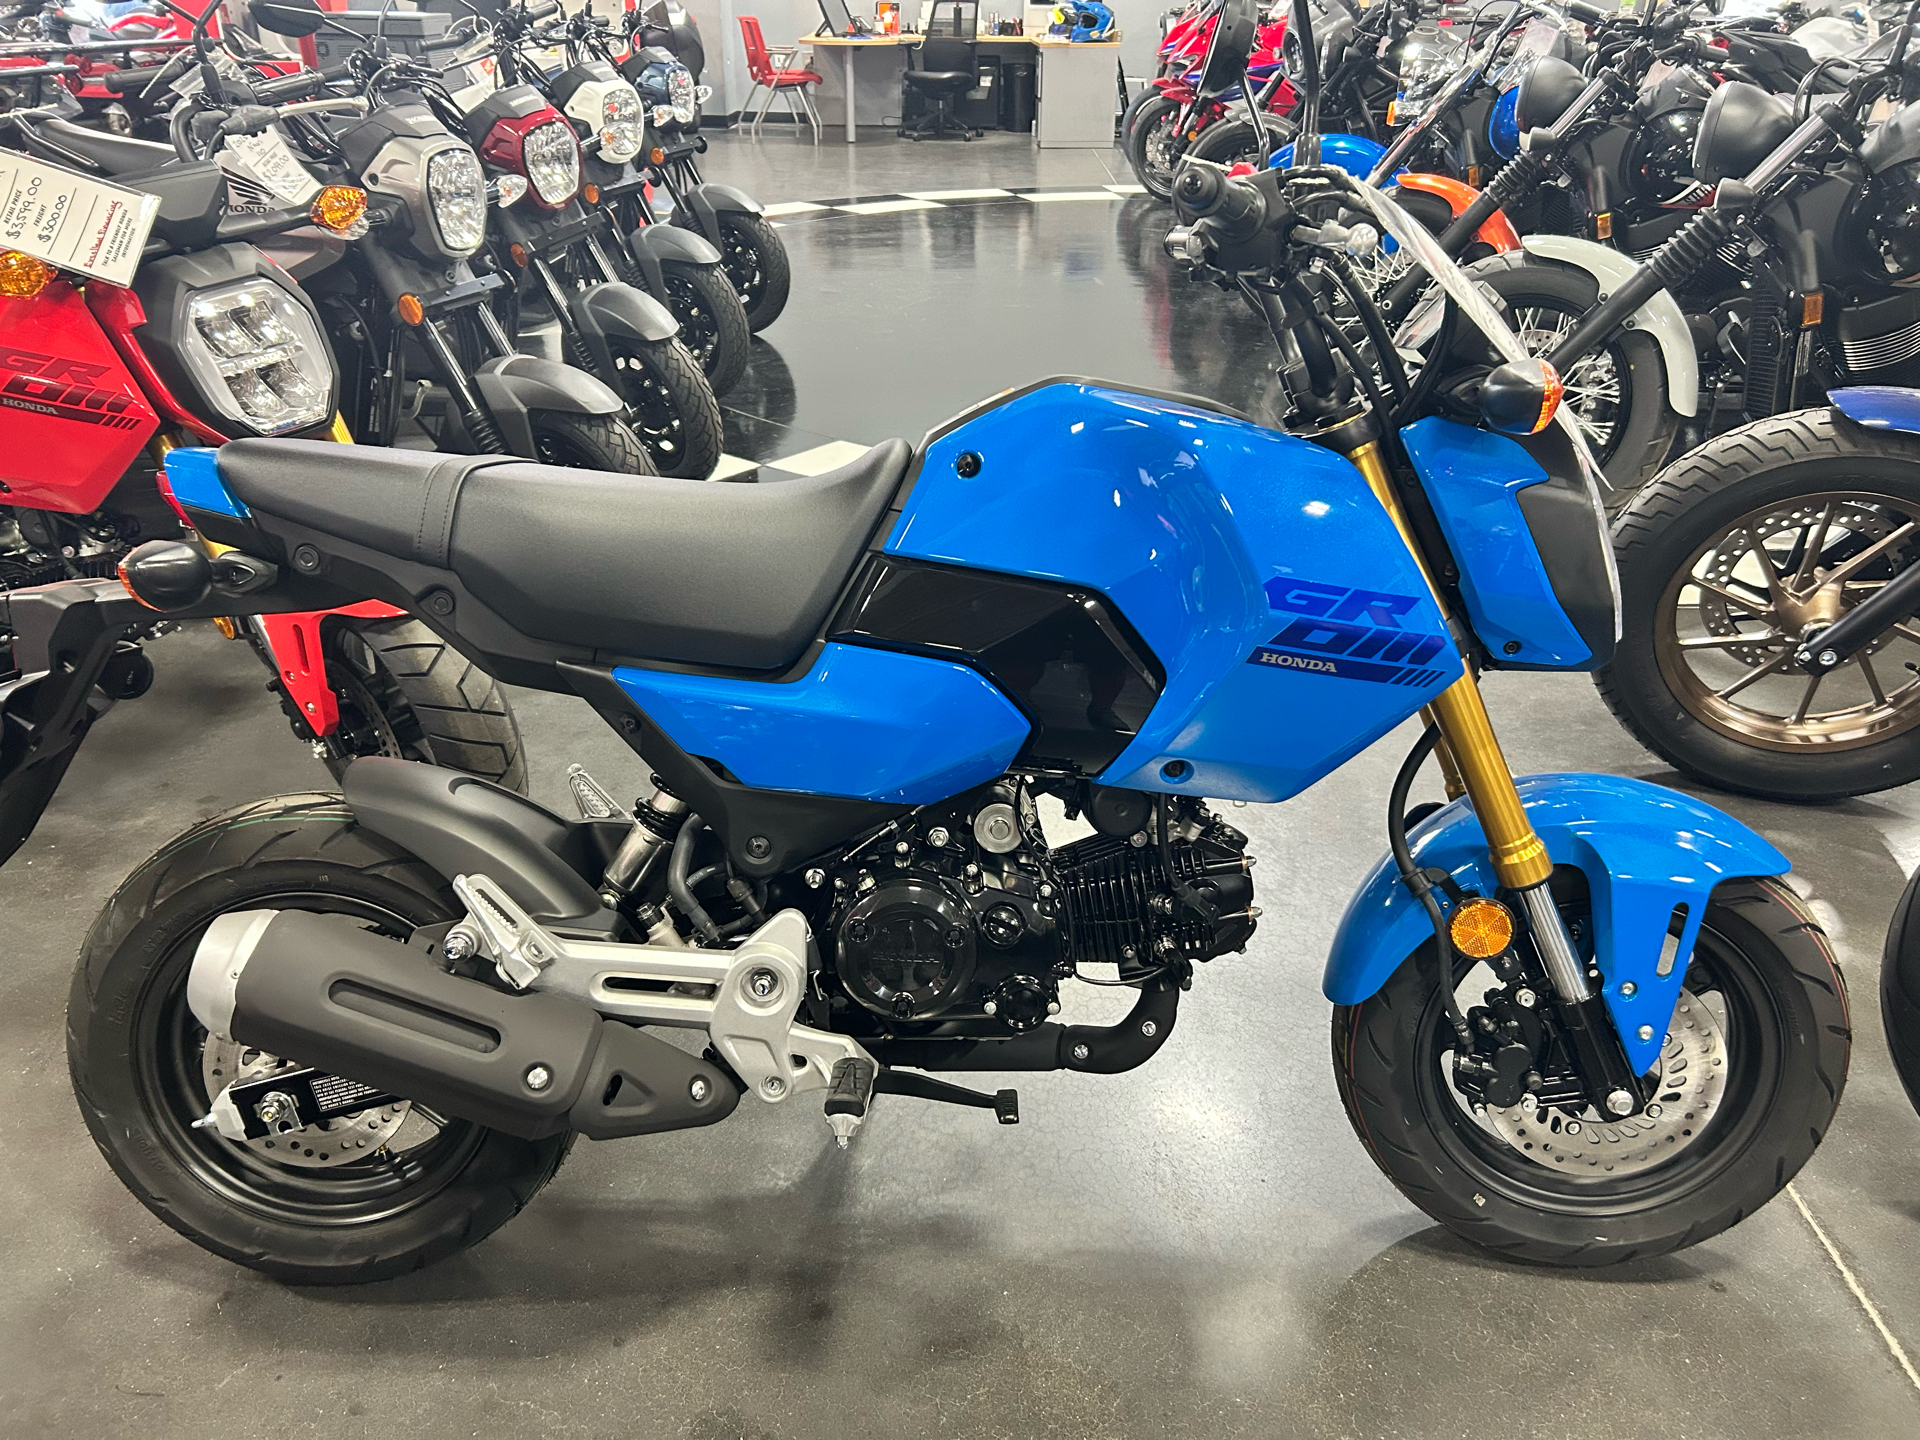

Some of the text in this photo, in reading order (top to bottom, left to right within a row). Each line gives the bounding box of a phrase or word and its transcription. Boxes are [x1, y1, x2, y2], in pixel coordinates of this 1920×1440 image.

[3, 188, 23, 225] RETAIL PRICE
[5, 176, 43, 240] $3,599.00
[32, 204, 47, 227] FREIGHT
[37, 194, 67, 244] $300.00
[2, 397, 59, 415] HONDA
[1260, 652, 1338, 673] HONDA
